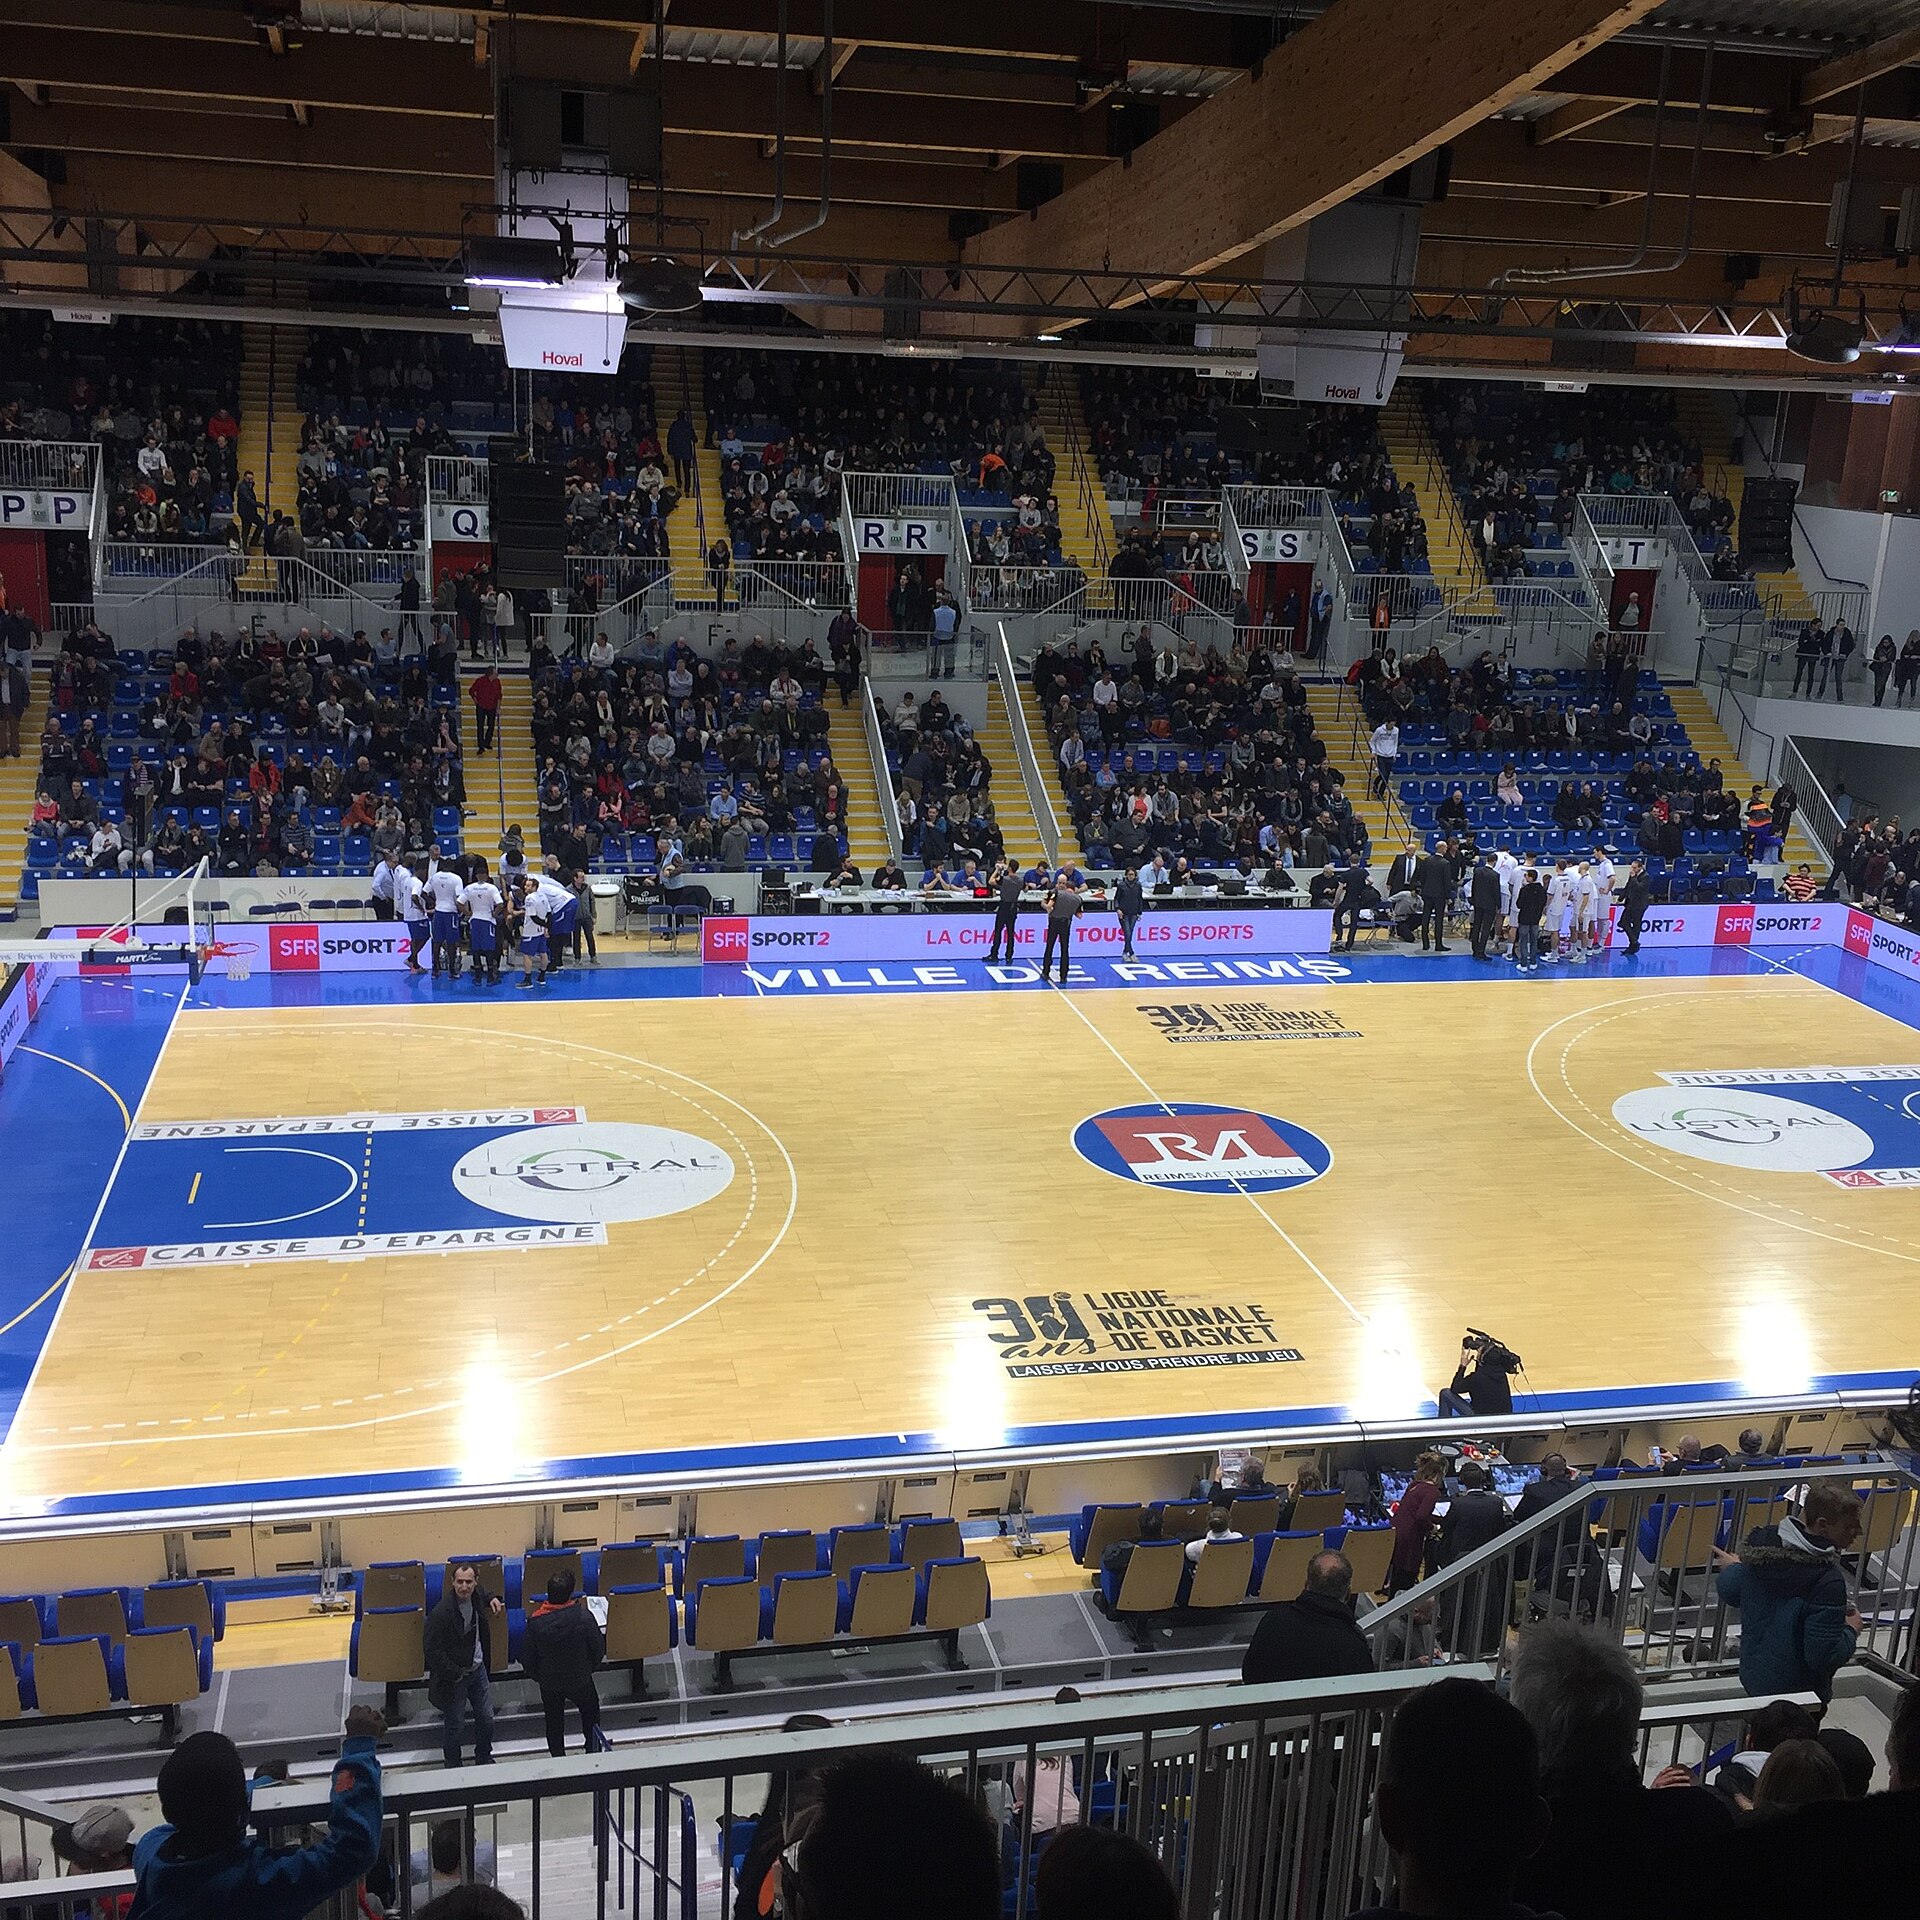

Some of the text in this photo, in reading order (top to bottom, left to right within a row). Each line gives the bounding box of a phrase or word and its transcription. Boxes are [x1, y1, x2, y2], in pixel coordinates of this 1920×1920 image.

[542, 351, 582, 366] Hoval
[1324, 384, 1360, 399] Hoval
[2, 495, 76, 524] P P
[452, 509, 478, 538] Q
[863, 522, 927, 549] R R
[1241, 533, 1298, 558] S S
[1628, 541, 1645, 565] T
[251, 615, 266, 639] E
[709, 624, 723, 646] F
[1121, 631, 1135, 652] G
[926, 929, 952, 944] LA
[1137, 926, 1171, 941] LES
[1178, 924, 1254, 940] SPORTS
[1723, 917, 1752, 933] SFR
[1850, 924, 1871, 945] SFR
[279, 939, 318, 956] SFR
[713, 931, 747, 948] SFR
[741, 966, 967, 988] VILLE
[1110, 959, 1352, 981] REIMS
[1211, 1002, 1274, 1013] LIGUE
[1221, 1010, 1342, 1022] NATIONALE
[1232, 1019, 1346, 1032] DE BASKET
[139, 1112, 530, 1138] CAISSE D'EPARGNE
[1629, 1115, 1843, 1132] LUSTRAL
[460, 1158, 718, 1178] LUSTRAL
[152, 1225, 595, 1260] CAISSE D'EPARGNE
[1083, 1290, 1176, 1310] LIGUE
[1096, 1304, 1274, 1332] NATIONALE
[1106, 1325, 1280, 1351] DE BASKET
[1012, 1350, 1298, 1378] LAISSEZ-VOUS PRENDRE AU JEU
